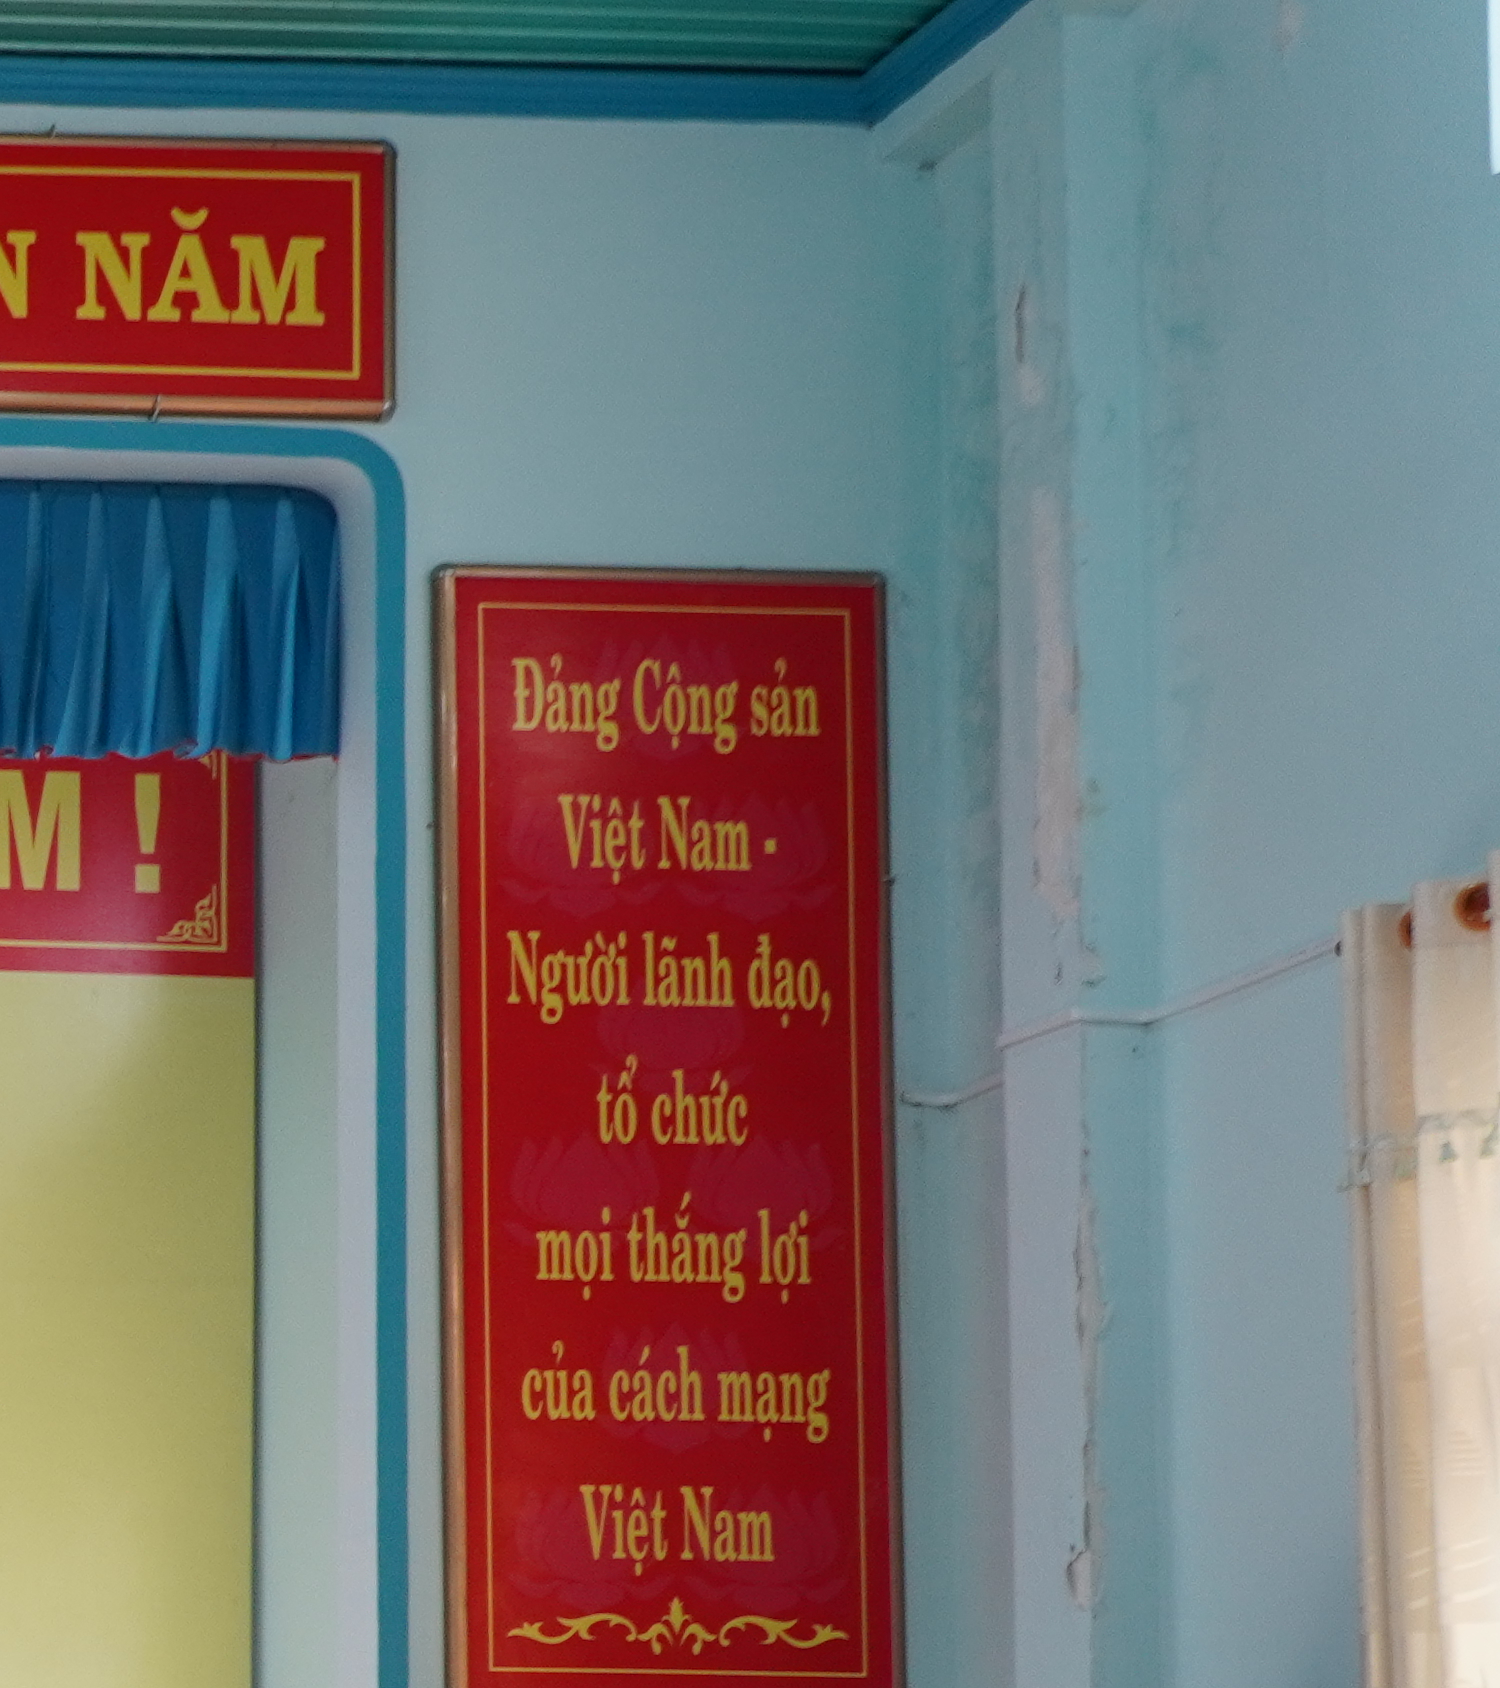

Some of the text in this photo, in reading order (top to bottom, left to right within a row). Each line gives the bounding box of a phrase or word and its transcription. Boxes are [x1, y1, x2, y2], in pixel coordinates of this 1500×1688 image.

[76, 208, 325, 326] NĂM
[512, 654, 820, 754] Đảng Cộng sản
[133, 774, 160, 893] !
[557, 793, 777, 884] Việt Nam -
[507, 930, 831, 1028] Người lãnh đạo,
[596, 1054, 747, 1146] tổ chức
[536, 1191, 811, 1303] mọi thắng lợi
[521, 1340, 830, 1443] của cách mạng
[579, 1484, 775, 1576] Việt Nam
